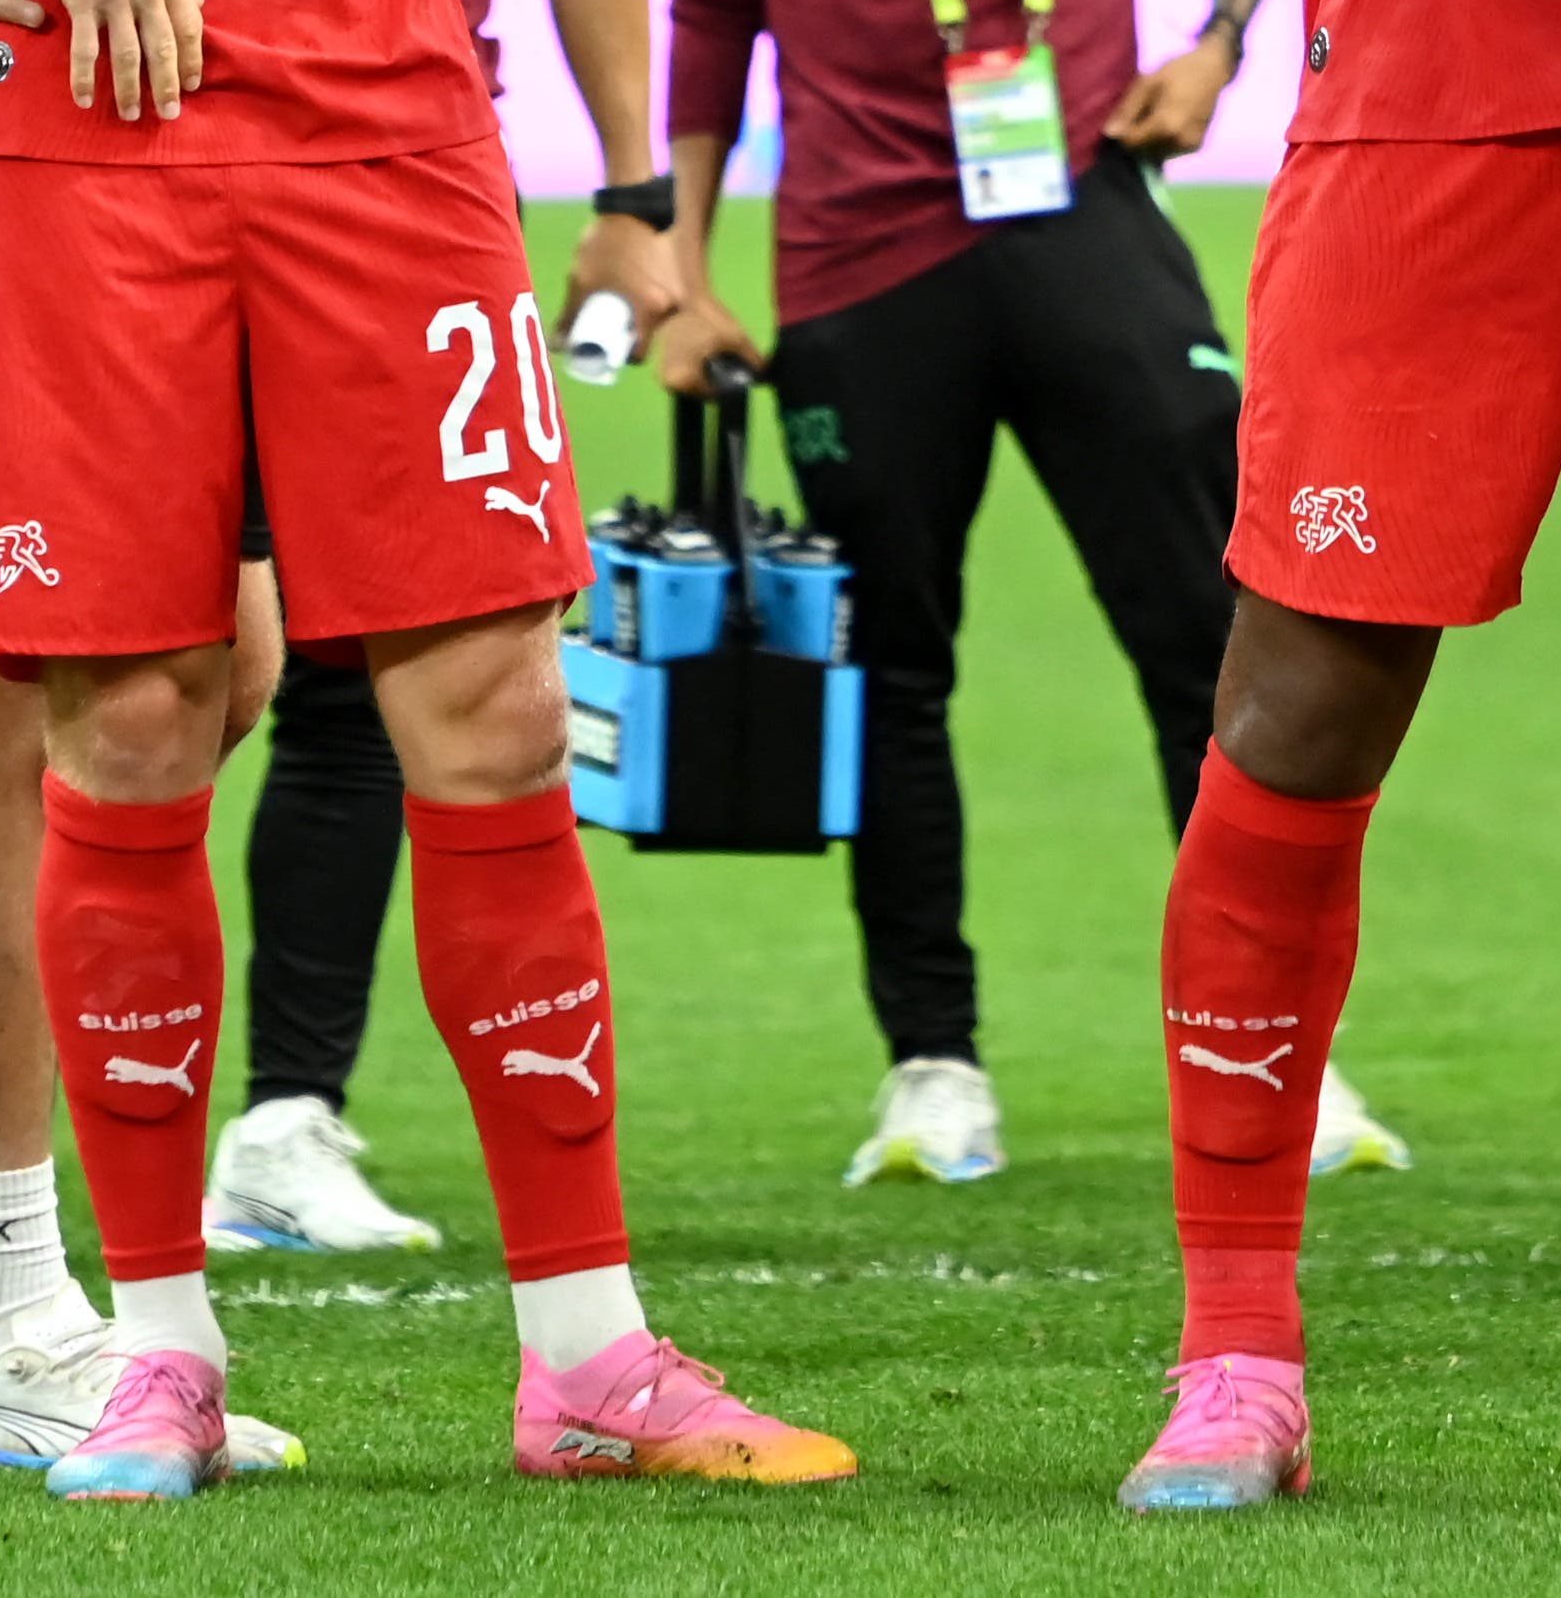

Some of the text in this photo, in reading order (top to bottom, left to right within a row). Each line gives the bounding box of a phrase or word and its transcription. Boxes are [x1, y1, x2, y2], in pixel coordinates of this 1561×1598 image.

[426, 291, 562, 483] 20
[79, 1003, 202, 1032] suisse
[468, 978, 600, 1036] suisse
[1166, 1008, 1299, 1031] suisse
